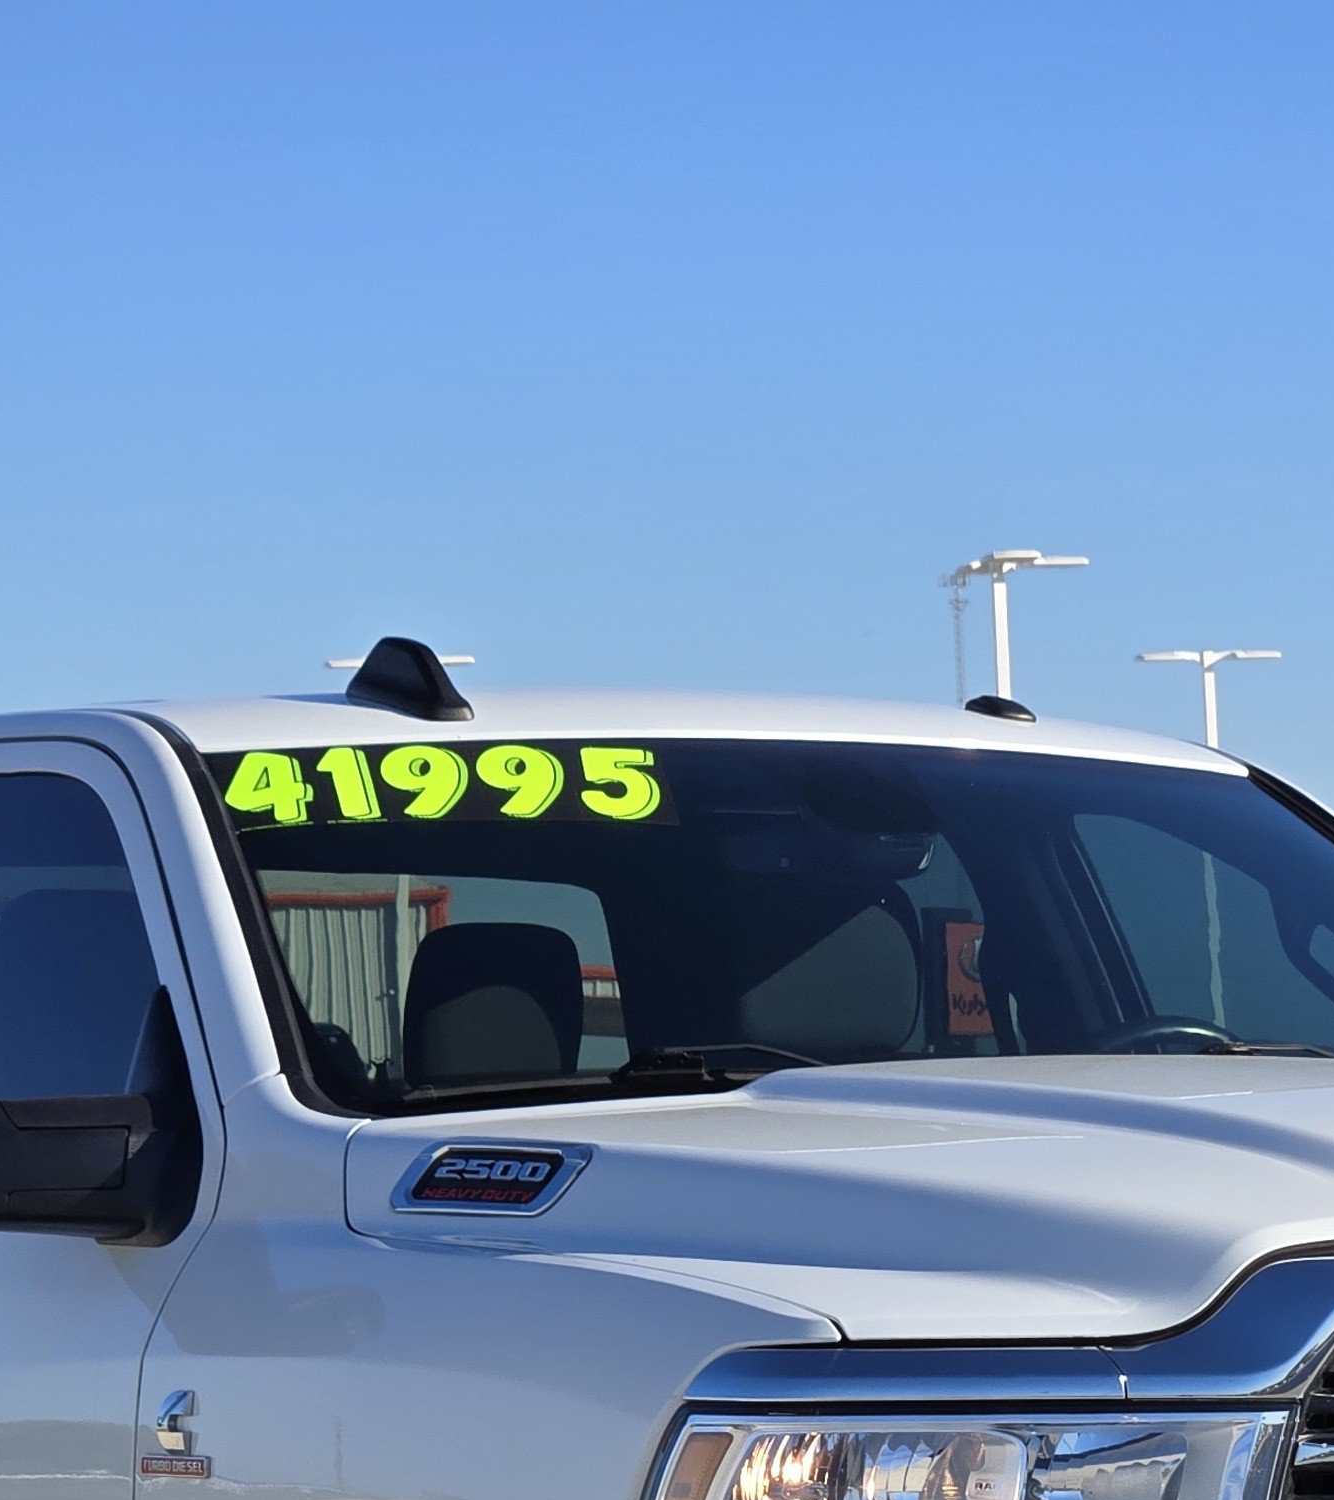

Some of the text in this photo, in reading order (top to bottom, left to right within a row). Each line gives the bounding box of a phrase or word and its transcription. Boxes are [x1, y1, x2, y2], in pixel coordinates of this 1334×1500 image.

[225, 745, 661, 822] 41995
[434, 1158, 552, 1182] 2500
[421, 1188, 535, 1202] HEAVY DUTY
[143, 1459, 203, 1474] TURBO DIESEL
